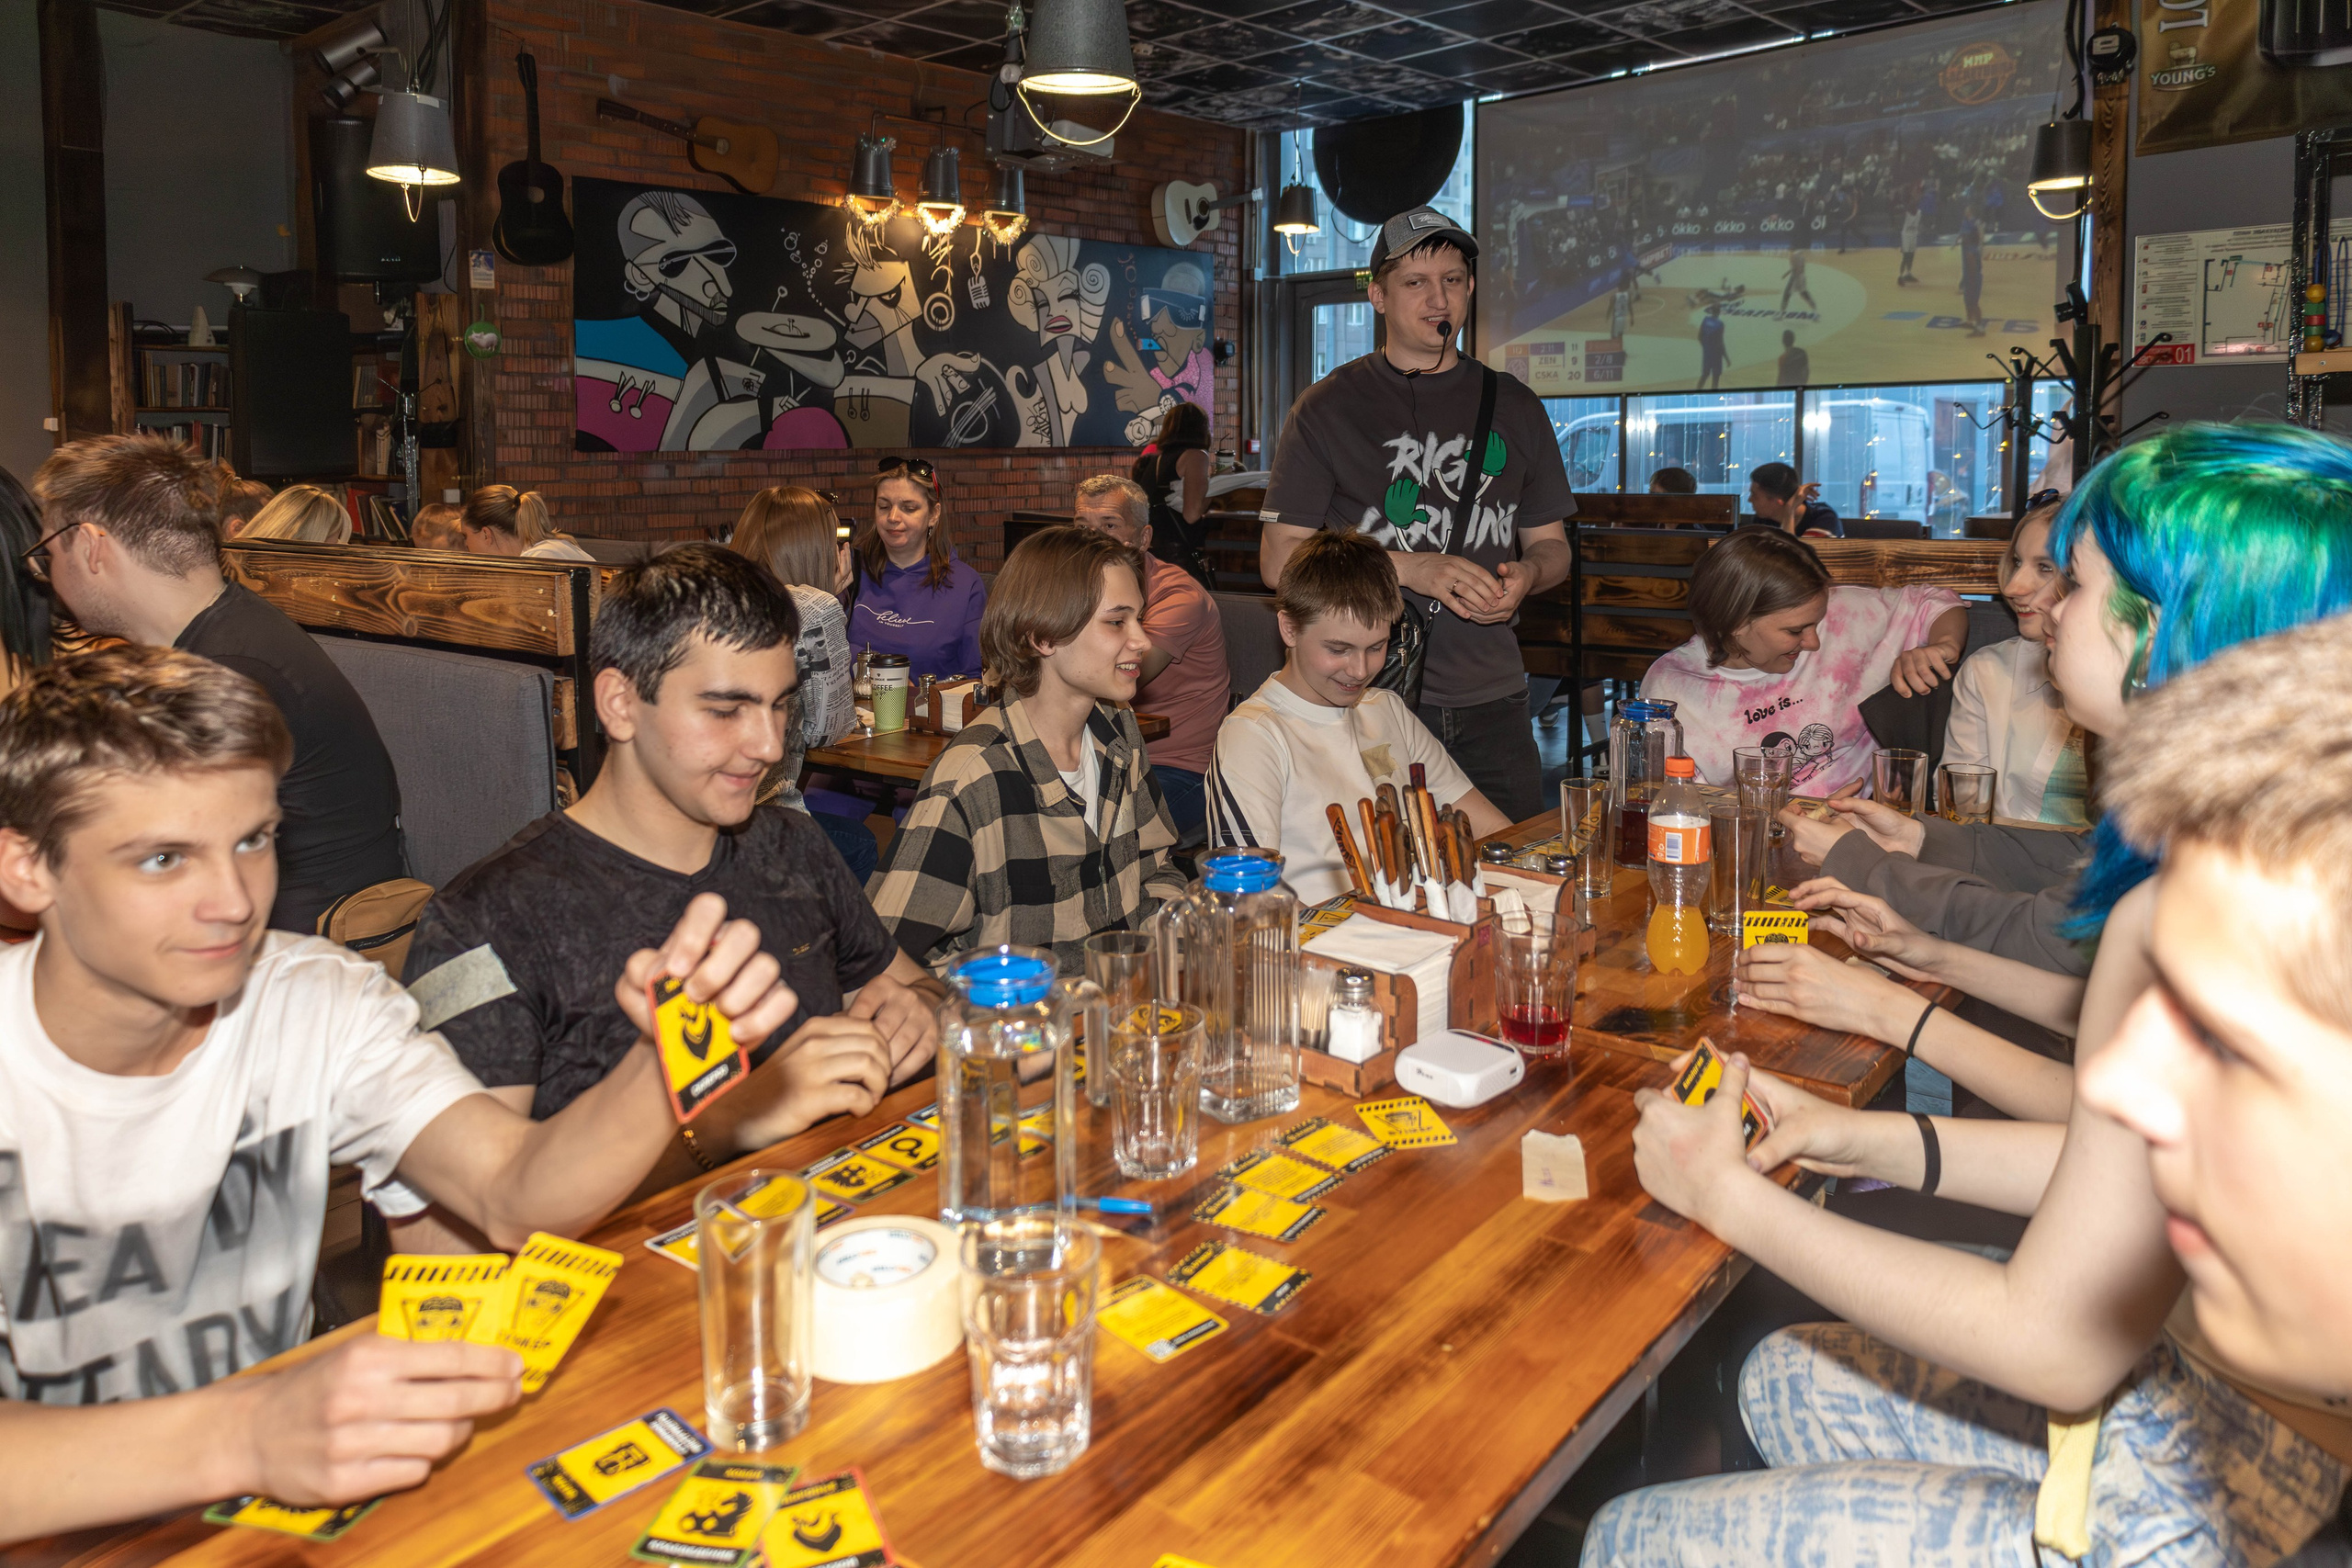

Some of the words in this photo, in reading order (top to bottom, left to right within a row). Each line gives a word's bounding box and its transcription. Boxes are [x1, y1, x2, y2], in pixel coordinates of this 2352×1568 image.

[2151, 66, 2216, 85] YOUNG'S
[1538, 355, 1556, 366] ZEN
[2175, 346, 2193, 364] 01
[1535, 371, 1559, 380] CSKA
[1567, 371, 1581, 380] 20
[1744, 705, 1776, 724] love
